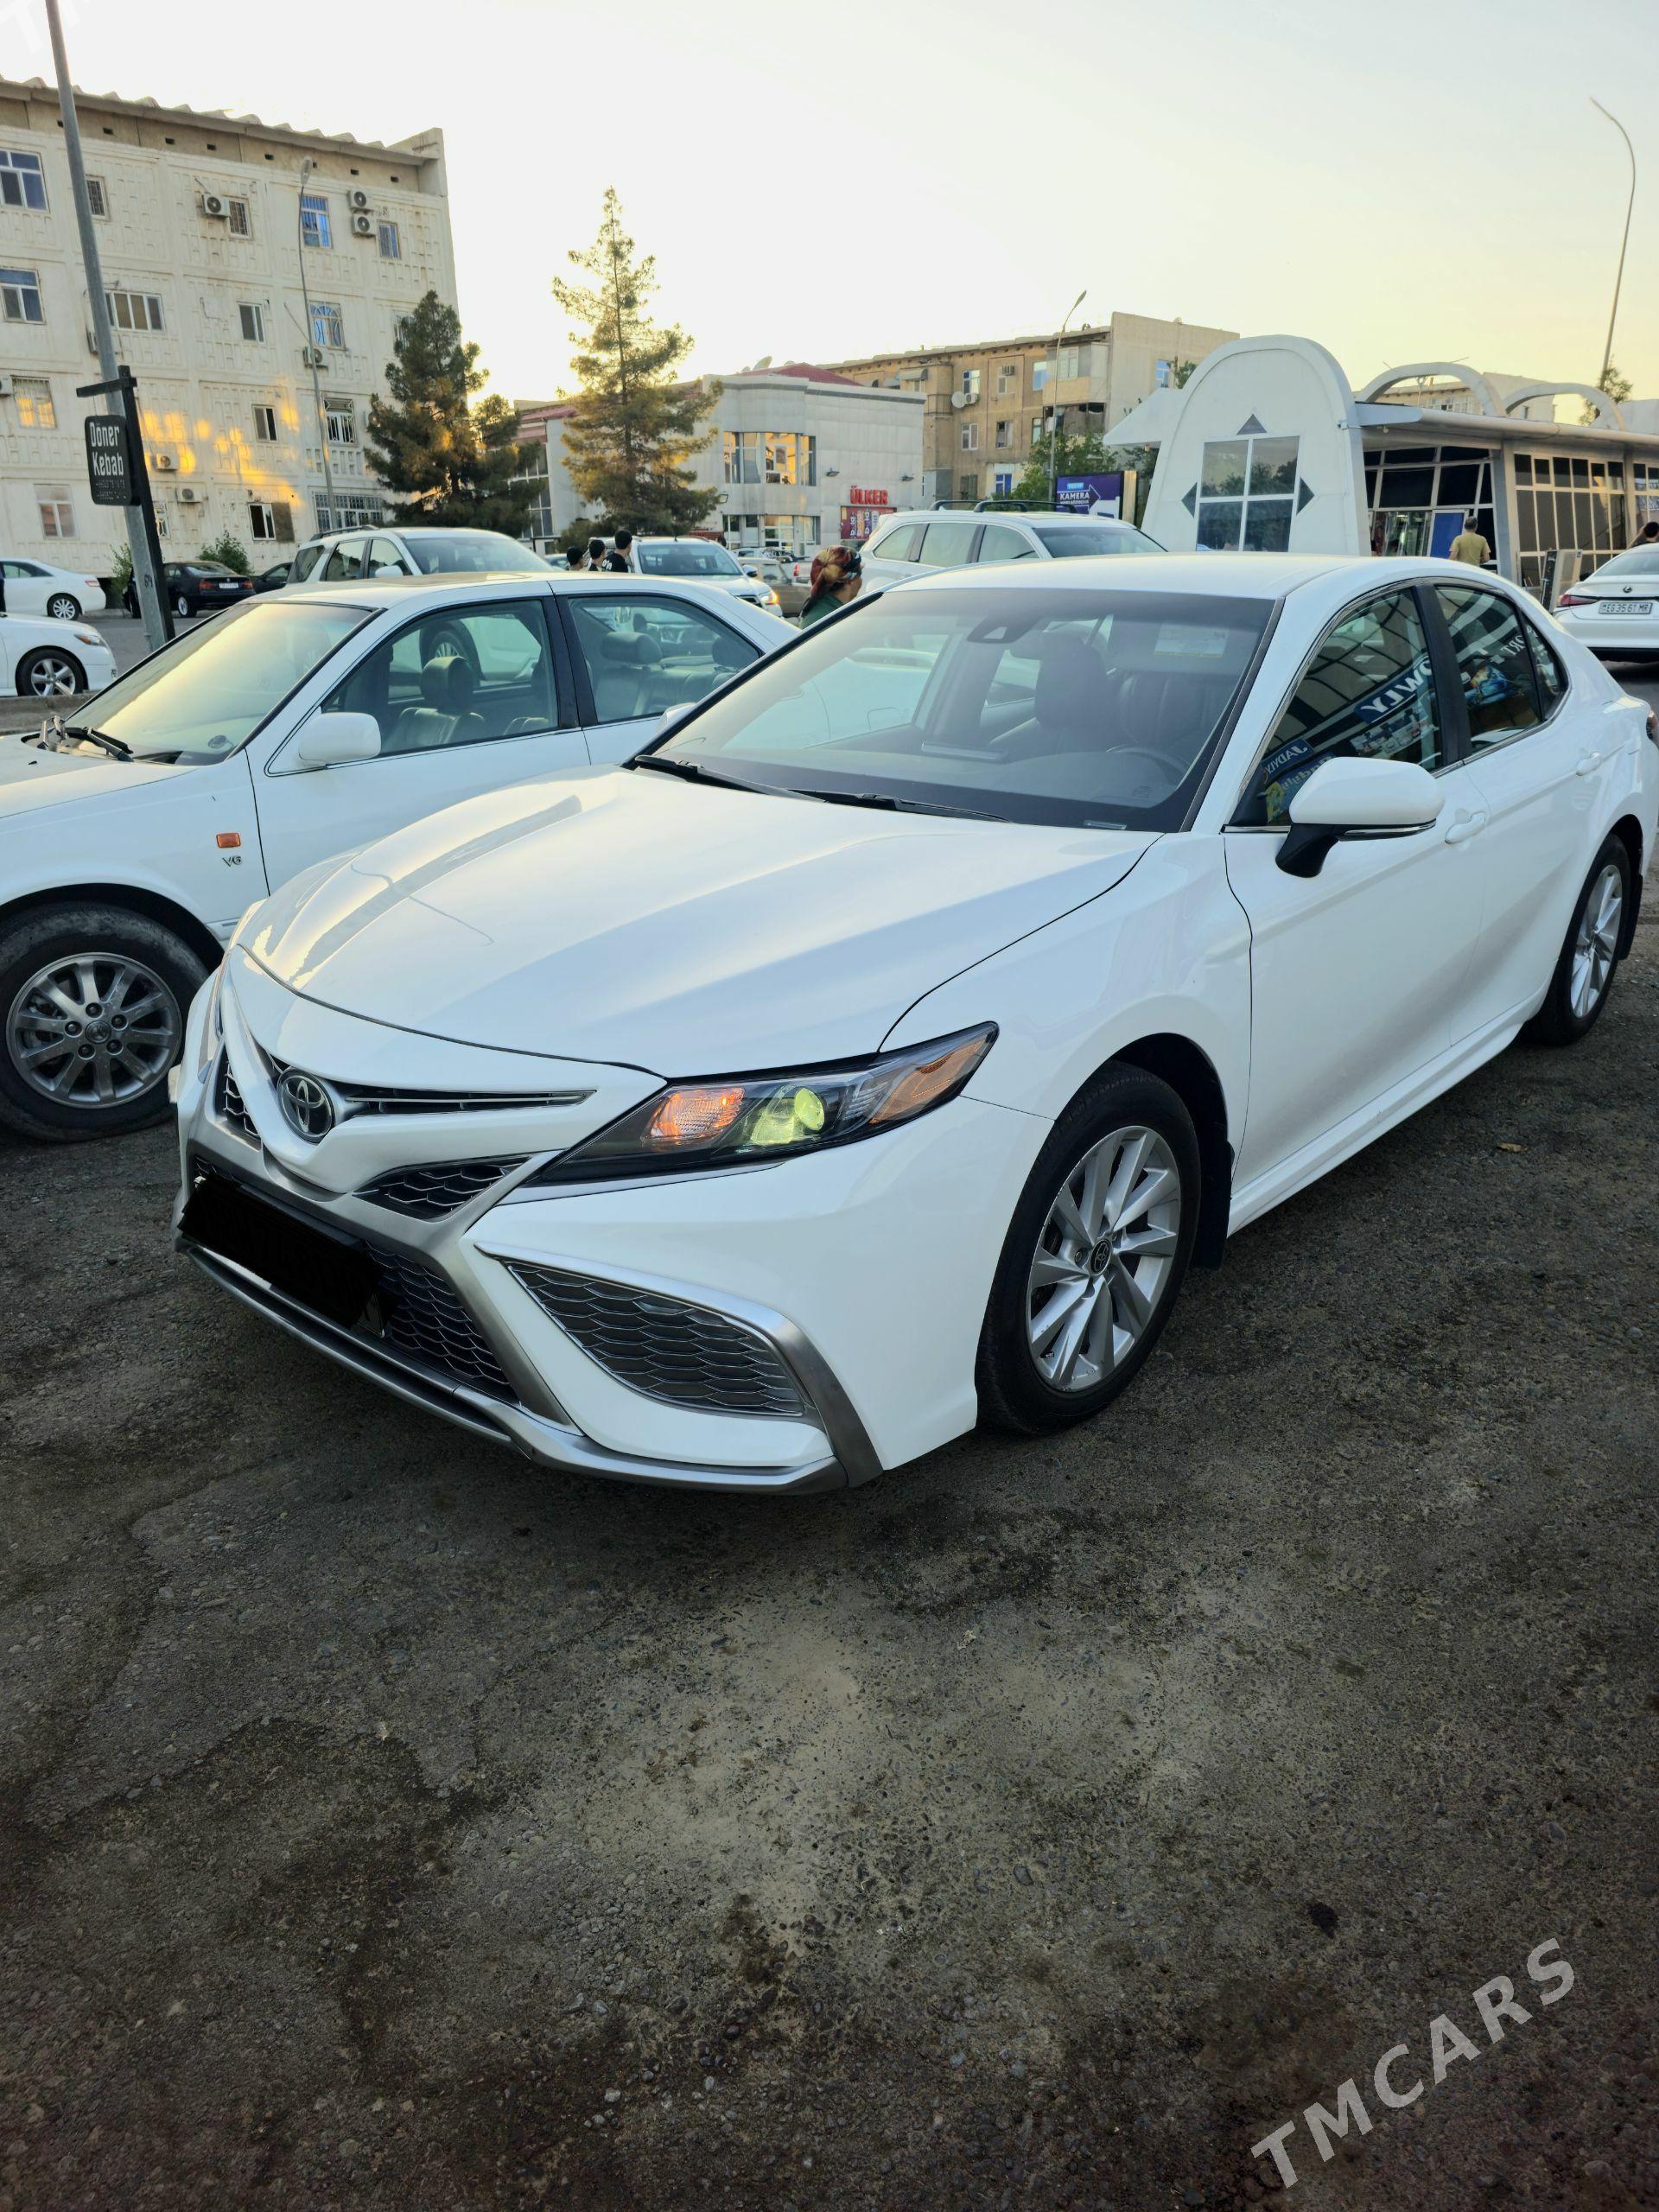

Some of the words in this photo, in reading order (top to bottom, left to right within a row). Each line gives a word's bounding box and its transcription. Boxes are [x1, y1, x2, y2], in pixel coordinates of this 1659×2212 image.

[89, 422, 120, 448] Döner
[92, 451, 124, 476] Kebab
[850, 484, 888, 505] ÜLKER
[1059, 492, 1090, 500] KAMERA
[222, 855, 242, 868] V6
